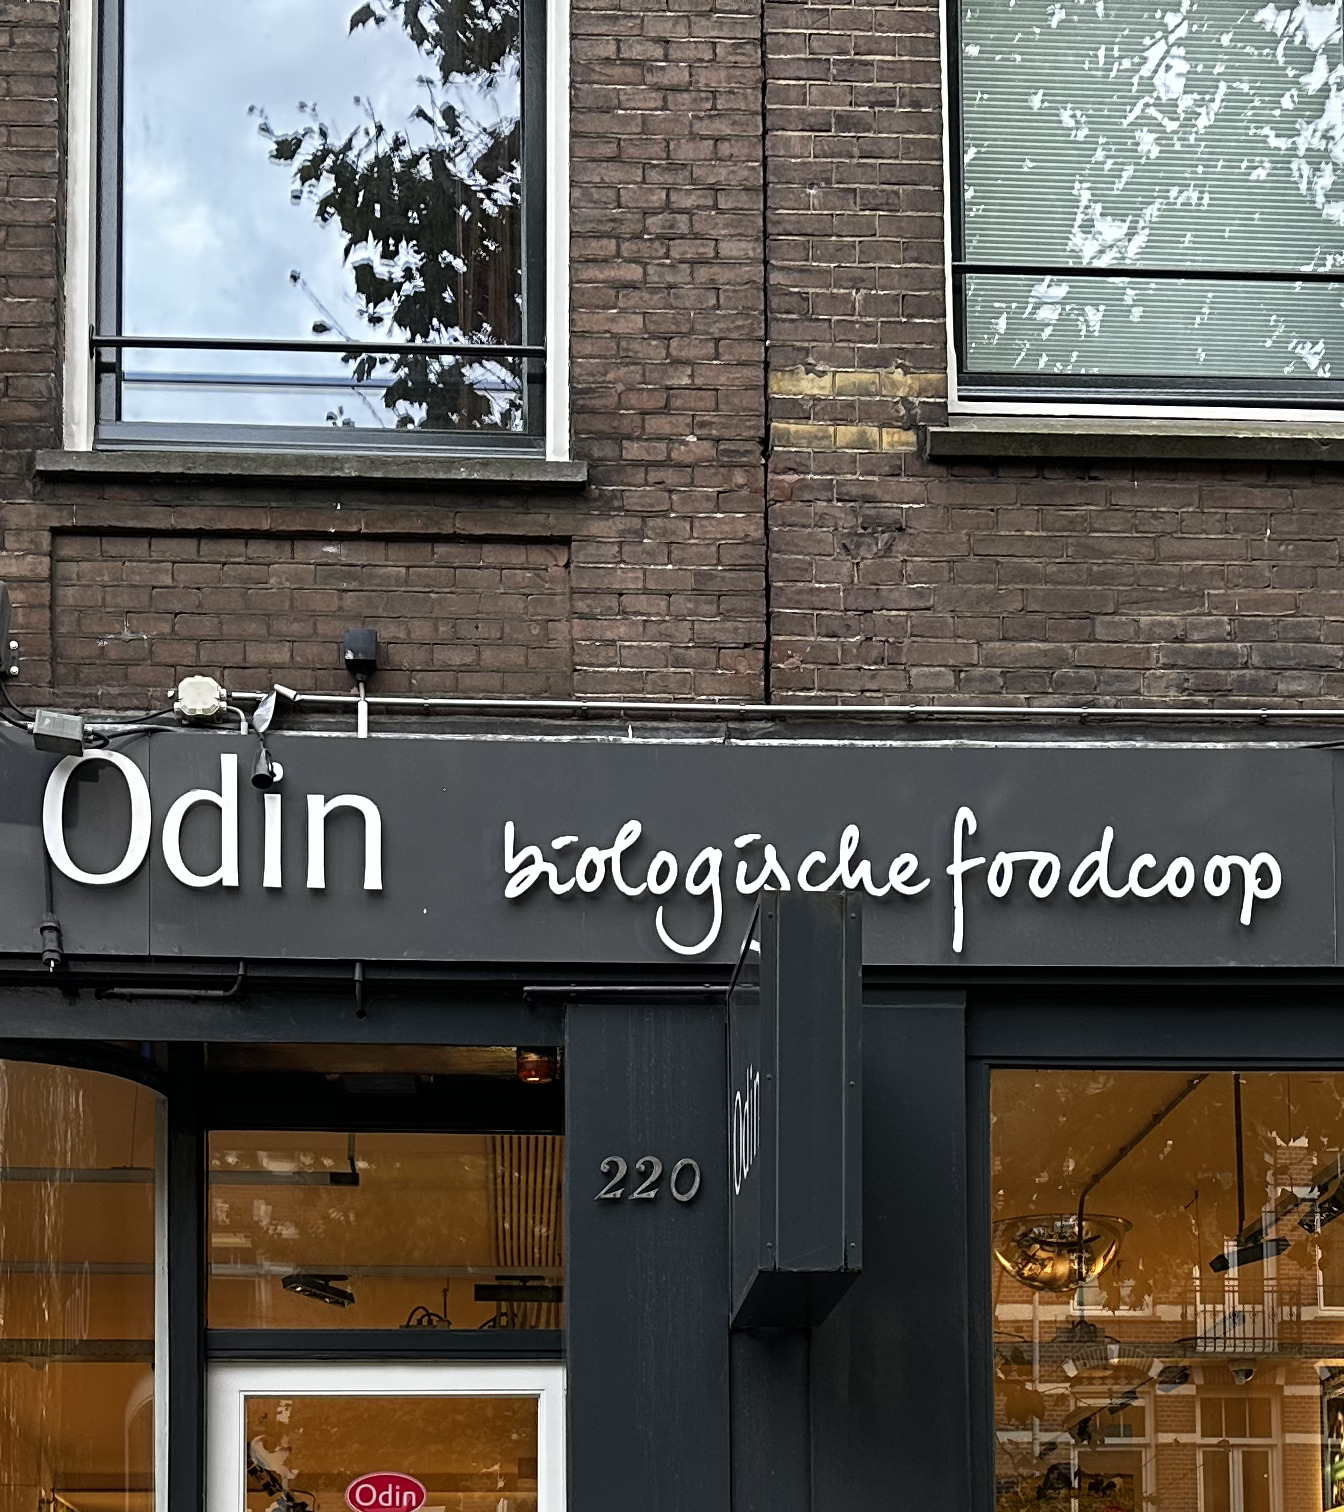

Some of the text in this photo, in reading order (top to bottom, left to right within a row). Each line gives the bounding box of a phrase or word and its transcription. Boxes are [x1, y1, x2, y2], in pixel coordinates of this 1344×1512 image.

[42, 748, 384, 890] Odin
[504, 805, 1283, 956] biologische foodcoop
[594, 1155, 703, 1204] 220
[733, 1062, 760, 1196] Odin
[355, 1483, 416, 1507] Odin
